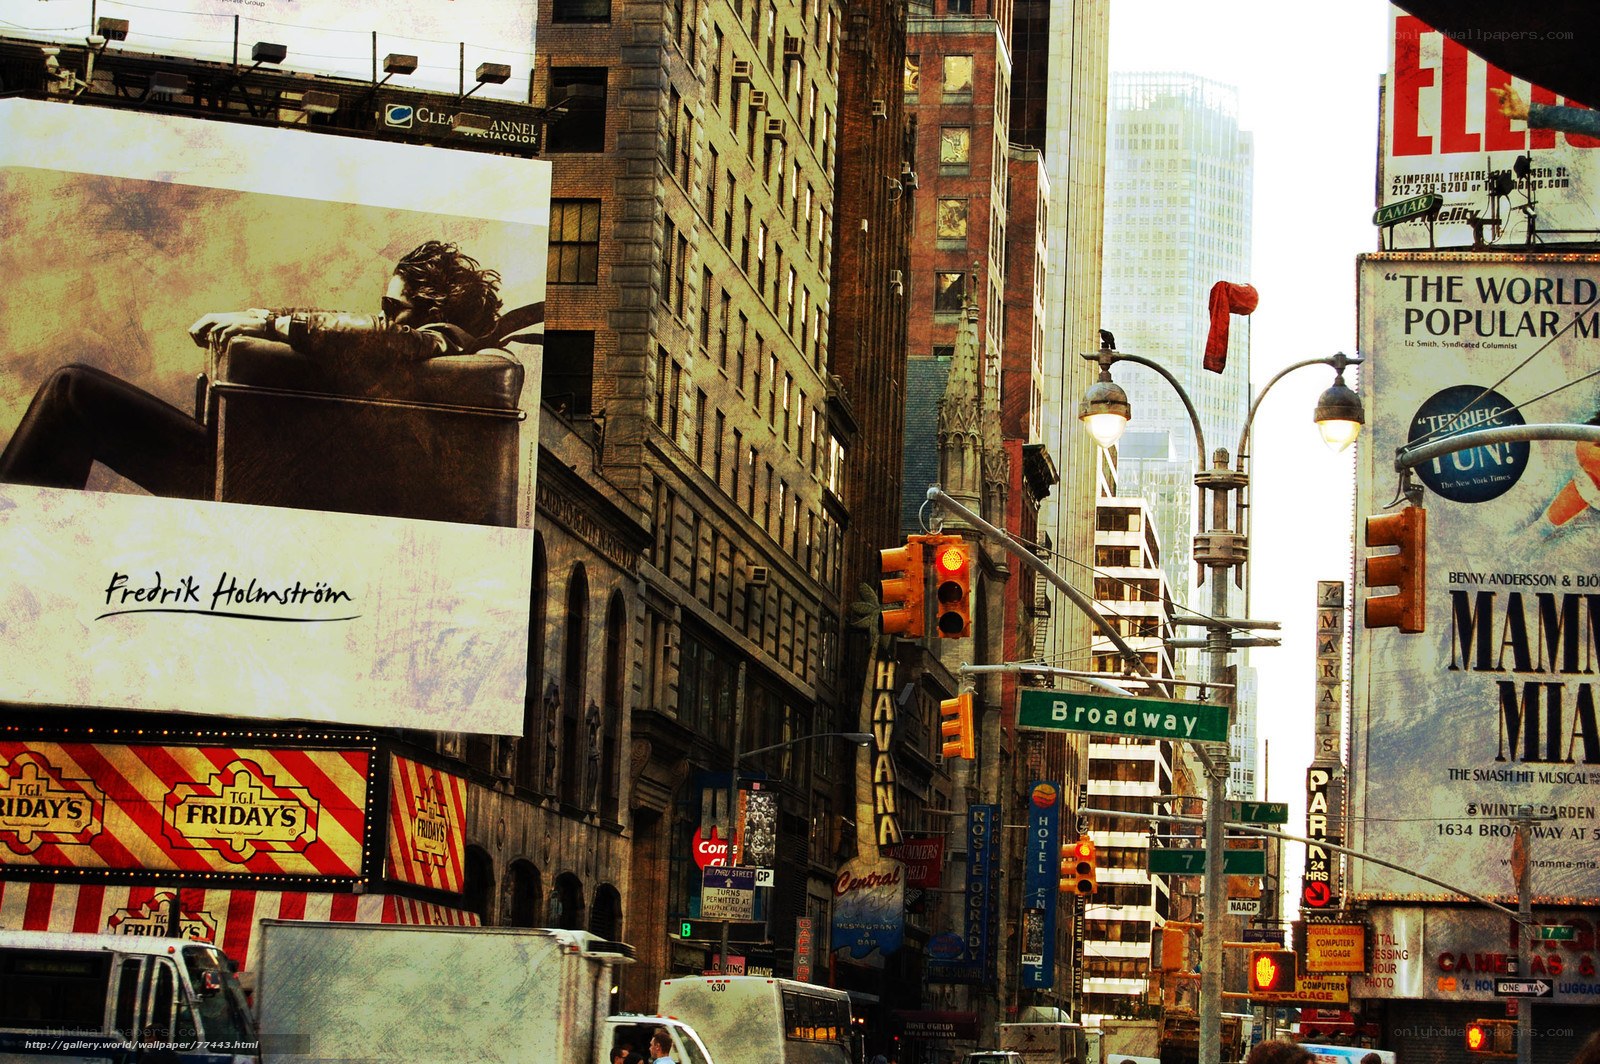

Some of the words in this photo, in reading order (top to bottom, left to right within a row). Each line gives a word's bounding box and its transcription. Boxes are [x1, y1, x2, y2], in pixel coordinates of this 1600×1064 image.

[416, 107, 454, 126] CLEA
[489, 120, 539, 136] ANNEL
[1403, 172, 1445, 184] IMPERIAL
[1449, 171, 1487, 182] THEATRE
[1392, 180, 1467, 195] 212-239-6200
[1376, 197, 1428, 223] LAMAR
[1475, 276, 1598, 305] WORLD
[1404, 308, 1559, 338] POPULAR
[1441, 341, 1480, 349] Syndicated
[1440, 481, 1454, 490] The
[1456, 479, 1471, 488] New
[1472, 477, 1489, 485] York
[1490, 474, 1511, 483] Times
[1449, 572, 1486, 584] BENNY
[1488, 573, 1557, 586] ANDERSSON
[1561, 575, 1571, 586] &
[104, 571, 200, 604] Fredrik
[211, 571, 355, 610] Holmström
[1321, 615, 1338, 752] MARAIS
[1051, 701, 1197, 736] Broadway
[873, 660, 900, 846] HAVANA
[1448, 768, 1471, 781] THE
[1473, 769, 1514, 782] SMASH
[1516, 771, 1535, 783] HIT
[1538, 772, 1588, 785] MUSICAL
[230, 791, 256, 804] T.G.I.
[186, 805, 297, 827] FRIDAY'S
[1249, 805, 1260, 820] 7
[1269, 805, 1282, 814] AV
[1437, 823, 1473, 836] 1634
[1569, 828, 1587, 840] AT
[1038, 817, 1049, 874] HOTEL
[1182, 854, 1193, 869] 7
[1311, 861, 1325, 870] 24
[834, 865, 900, 896] Central
[1305, 871, 1328, 882] HRS
[706, 896, 740, 904] PERMITTED
[1230, 902, 1257, 912] NAACP
[1546, 927, 1555, 938] 7
[1316, 939, 1355, 947] COMPUTERS
[711, 984, 726, 992] 630
[1302, 981, 1345, 991] COMPUTERS
[1364, 978, 1394, 988] PHOTO
[1502, 984, 1520, 992] ONE
[1527, 984, 1545, 992] WAY
